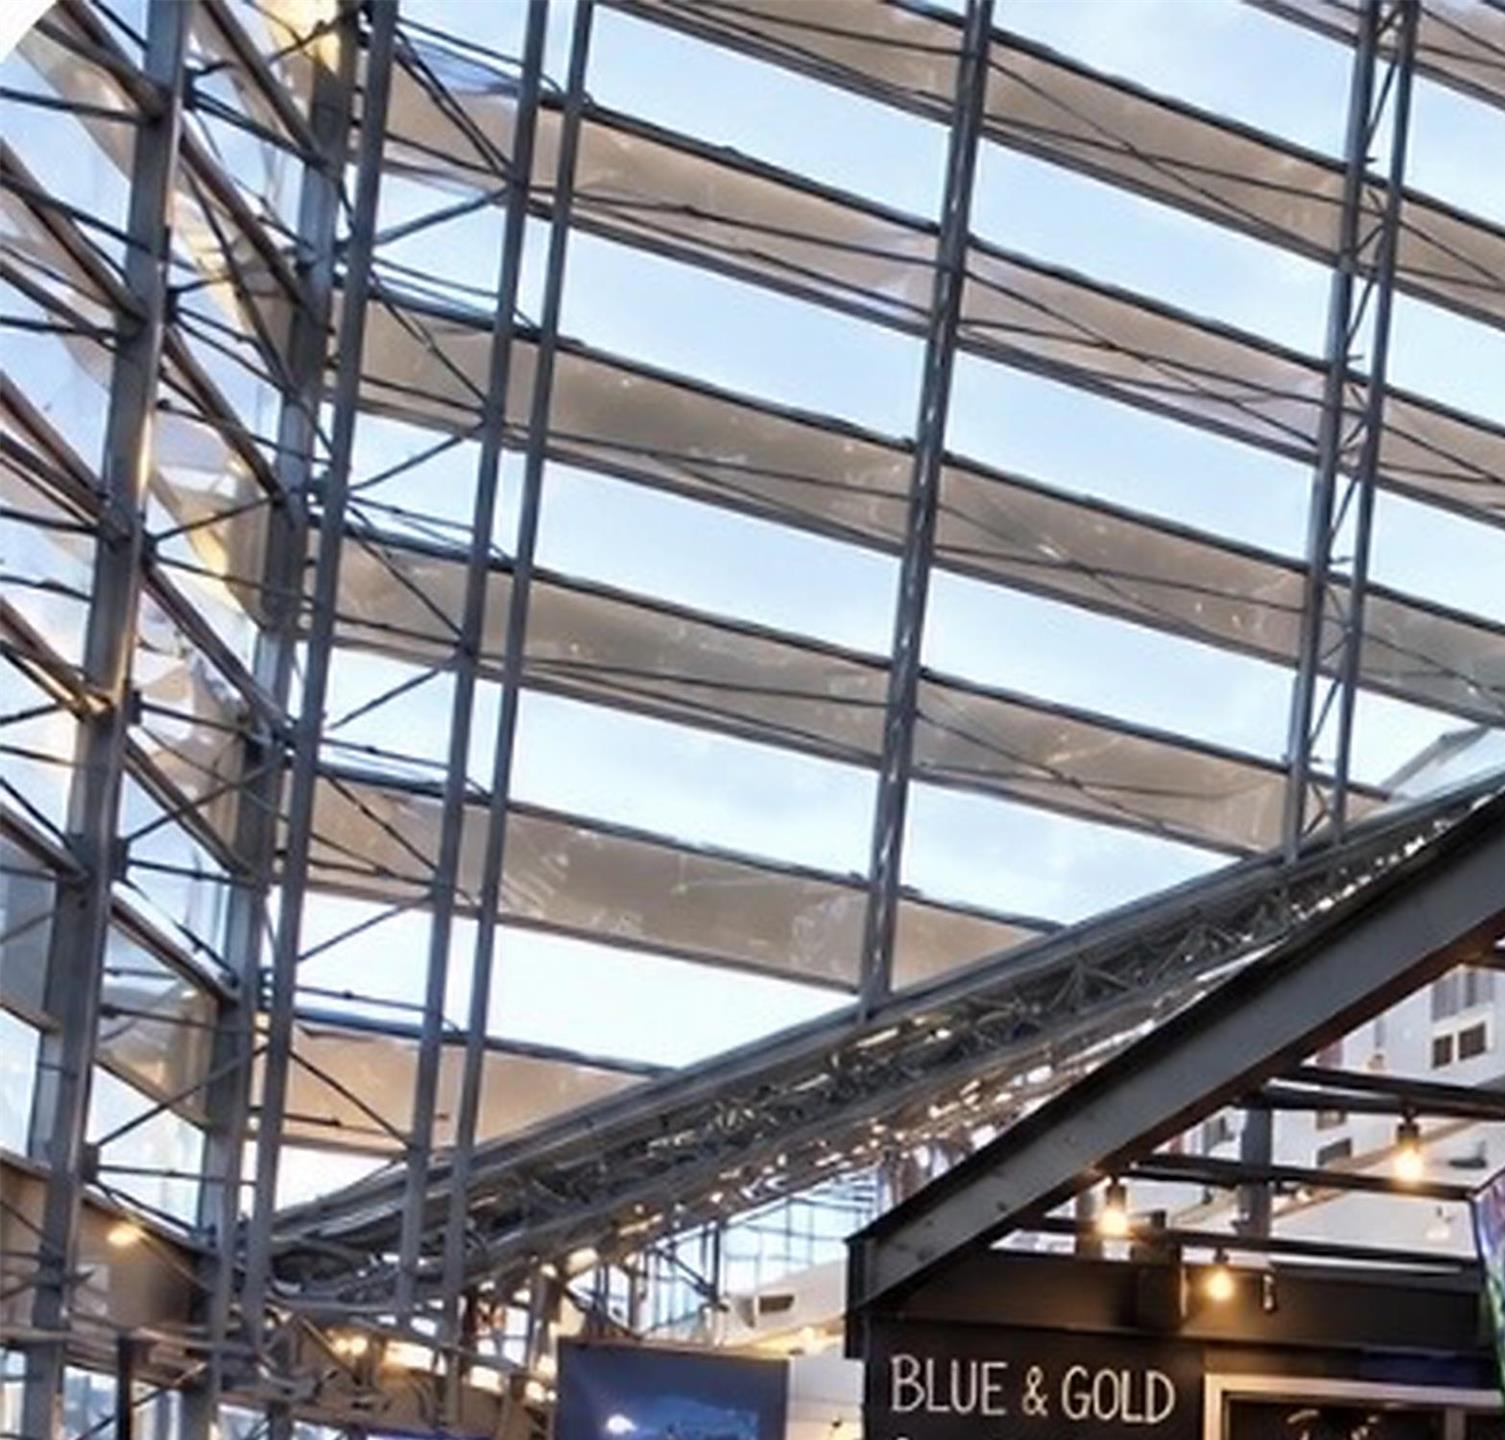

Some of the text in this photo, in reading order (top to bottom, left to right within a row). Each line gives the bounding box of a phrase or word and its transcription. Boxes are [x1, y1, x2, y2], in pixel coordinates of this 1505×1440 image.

[891, 1354, 1176, 1424] BLUE & GOLD
